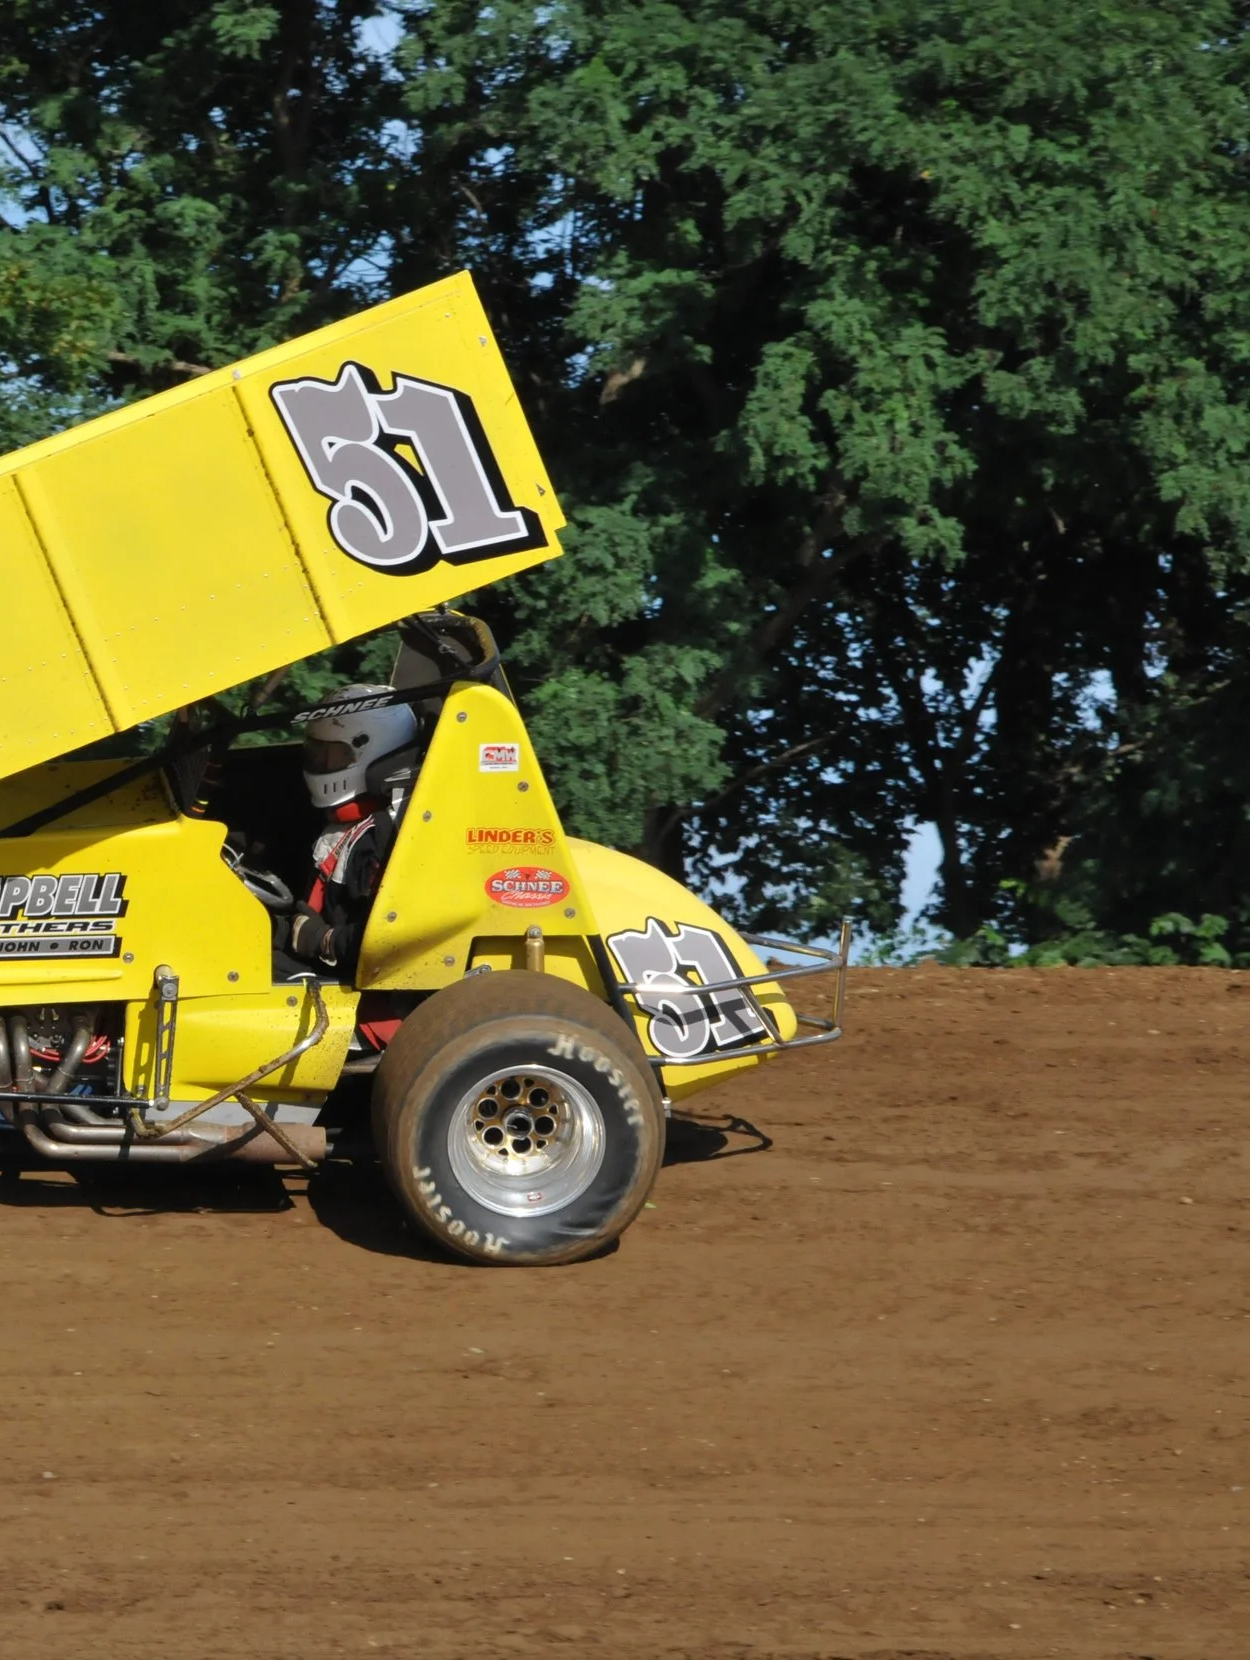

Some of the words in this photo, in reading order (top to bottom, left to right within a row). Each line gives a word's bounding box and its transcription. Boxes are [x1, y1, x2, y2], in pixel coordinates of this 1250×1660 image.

[269, 360, 549, 577] 51
[290, 695, 394, 726] SCHNEE
[467, 828, 556, 846] LINDER'S
[491, 879, 564, 893] SCHNEE
[68, 938, 104, 951] RON
[607, 916, 780, 1059] 51
